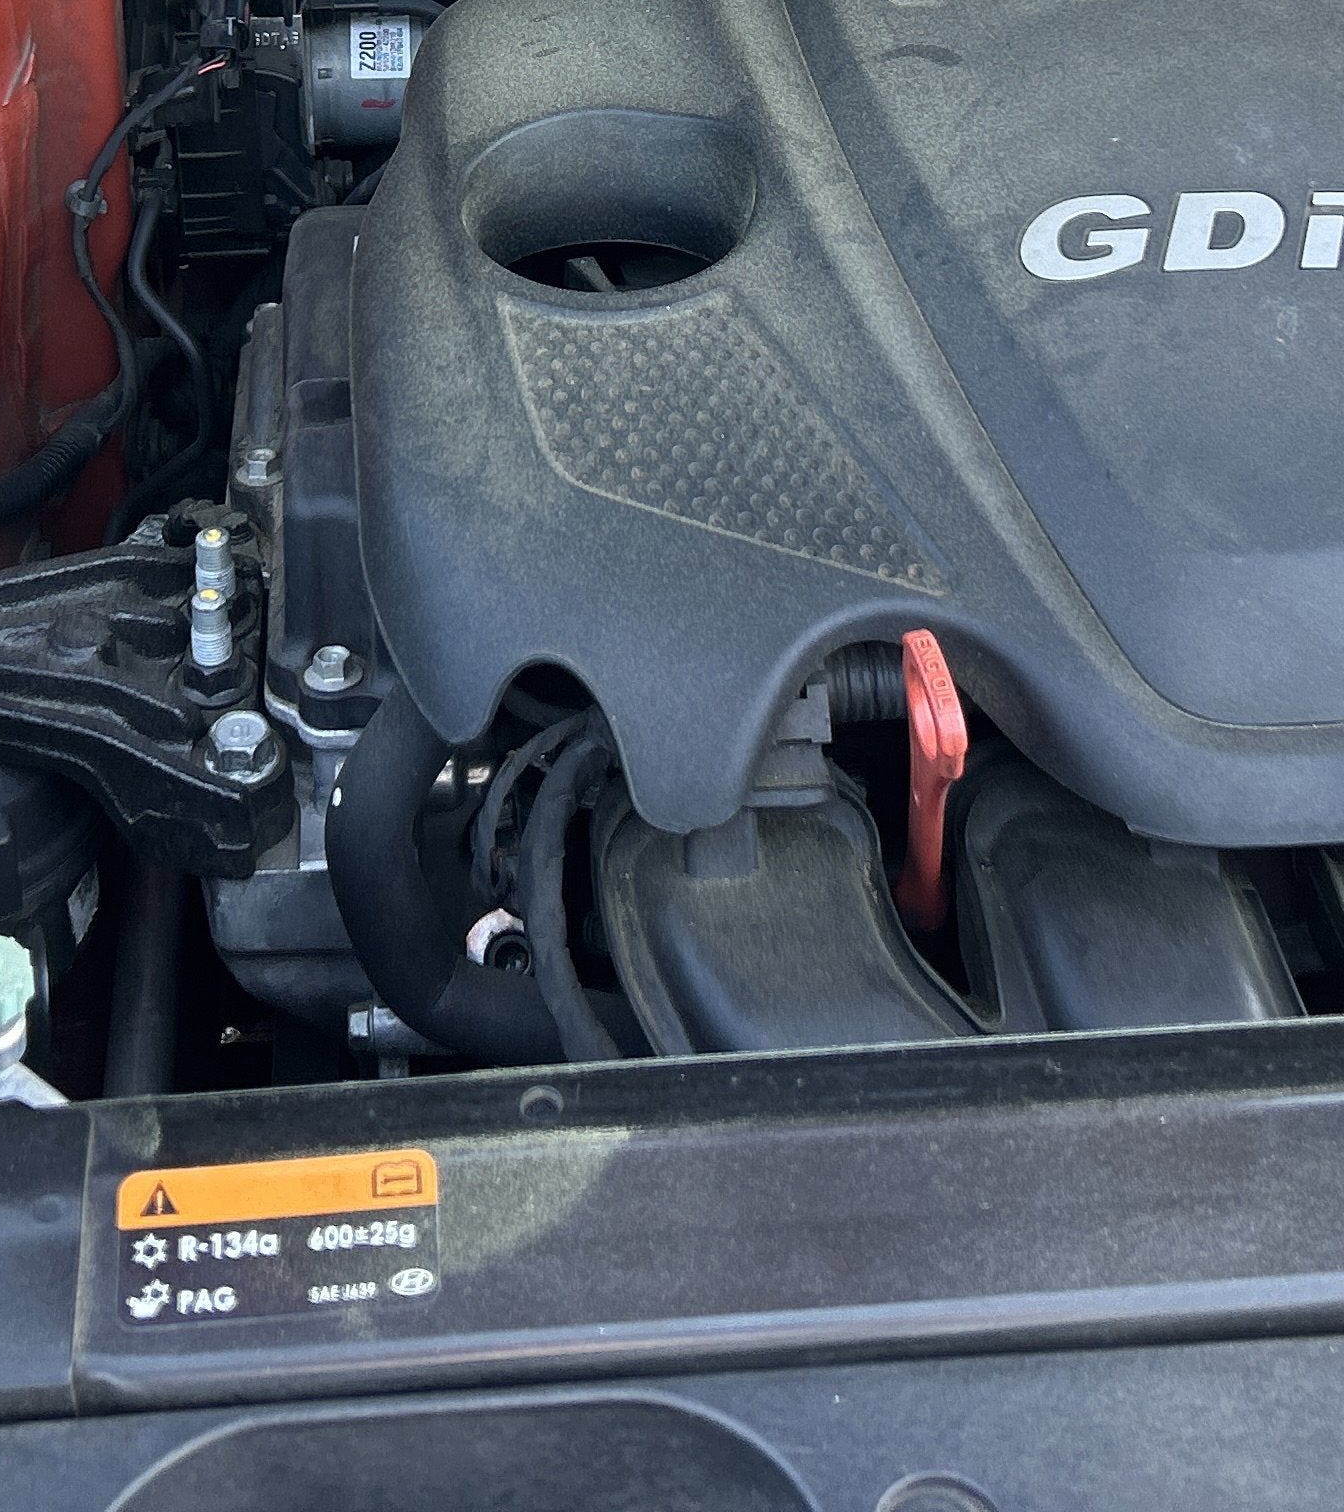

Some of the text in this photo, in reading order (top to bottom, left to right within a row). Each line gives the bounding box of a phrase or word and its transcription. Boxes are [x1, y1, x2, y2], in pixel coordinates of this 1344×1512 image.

[359, 31, 376, 71] Z200
[915, 638, 954, 710] ENG OIL
[178, 1220, 417, 1263] R-134a 600±25g
[176, 1285, 238, 1315] PAG
[307, 1284, 339, 1304] SAE
